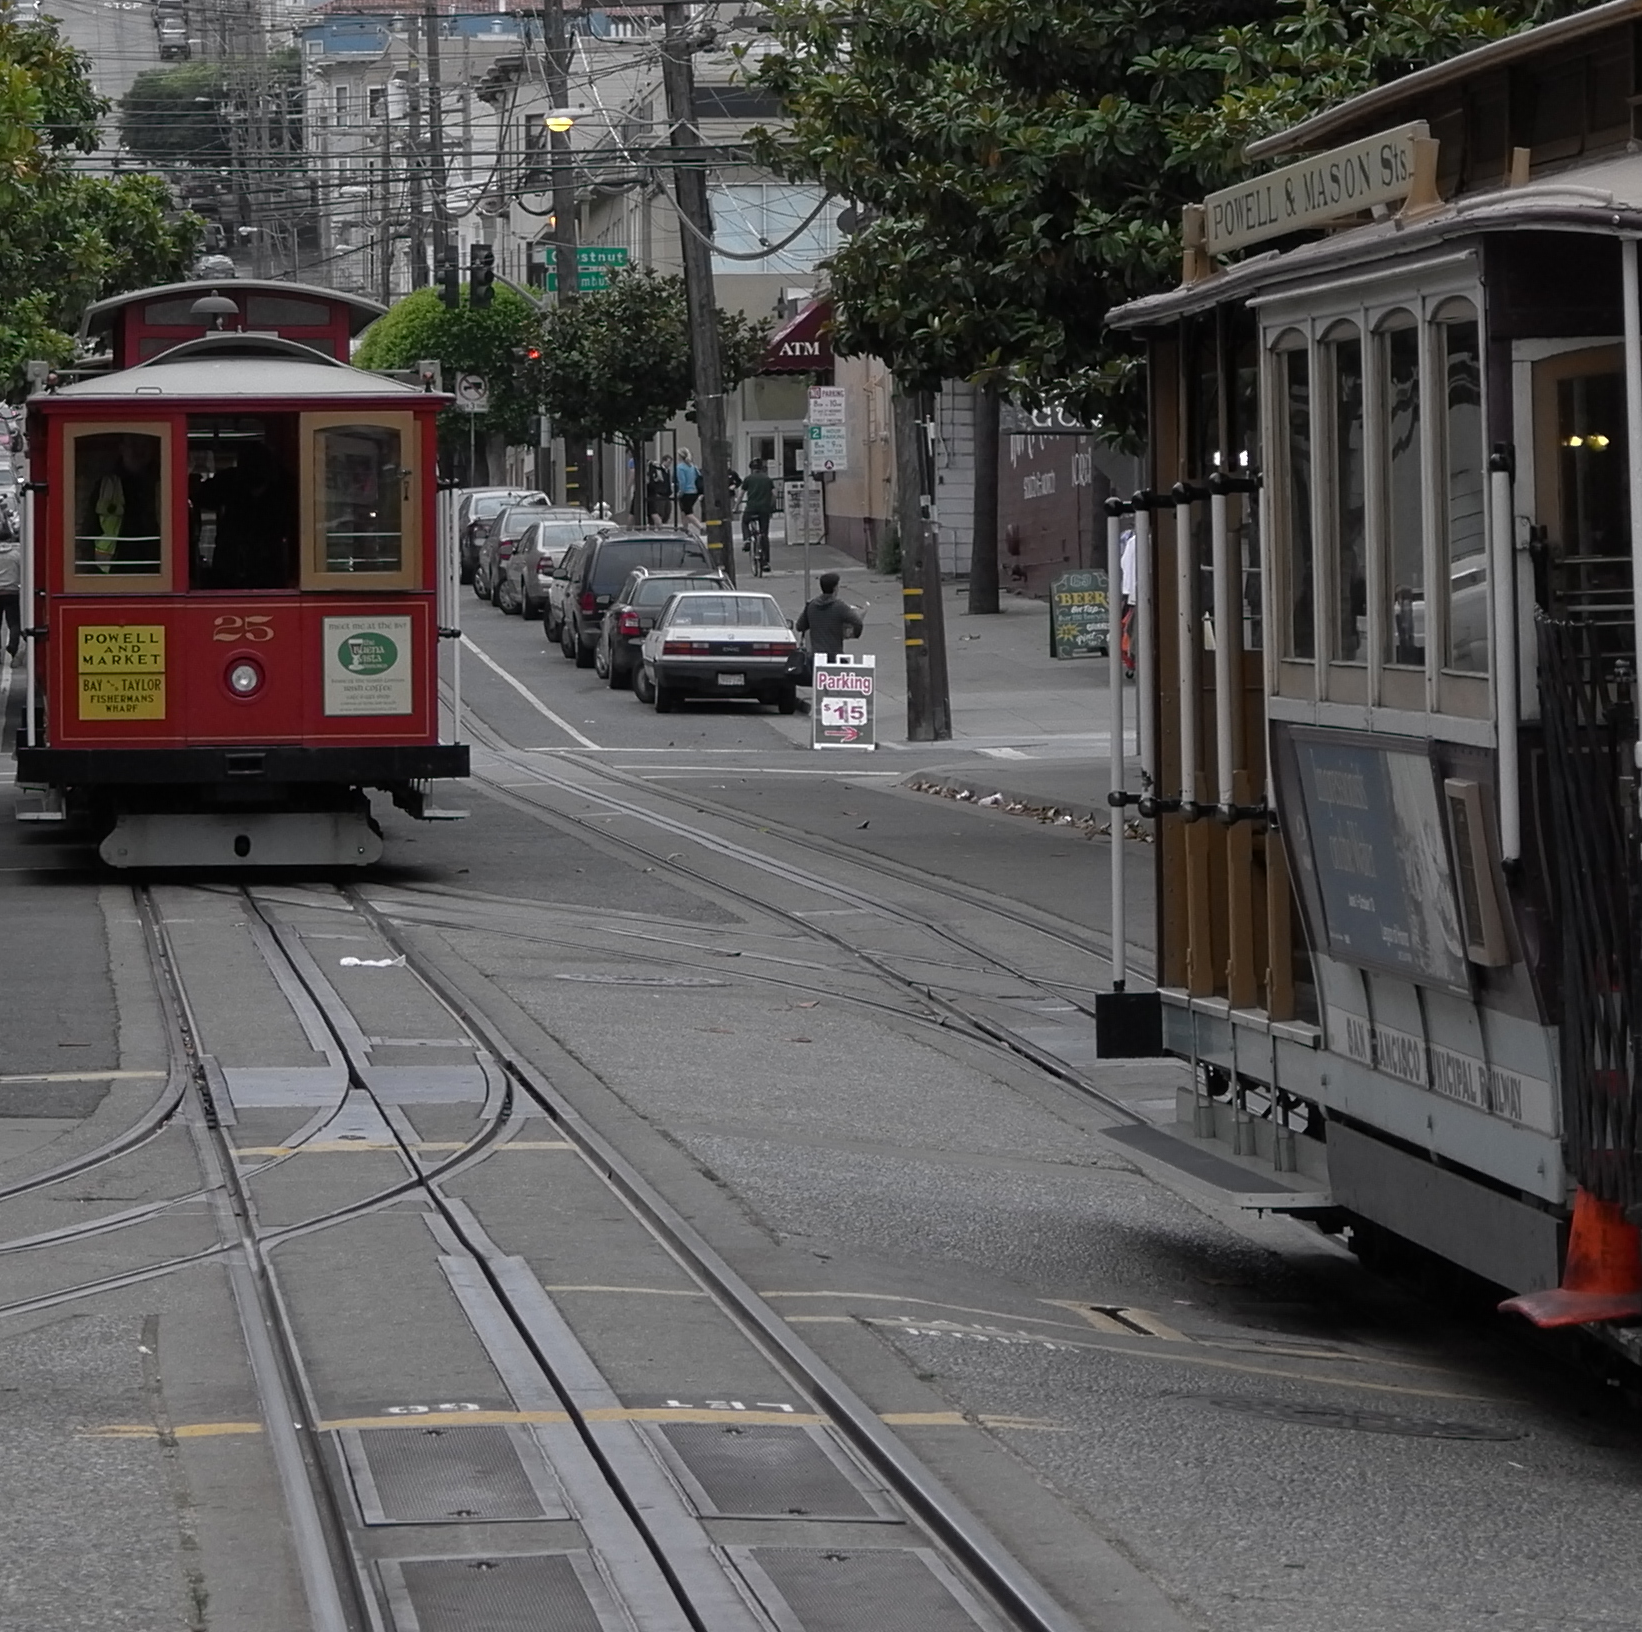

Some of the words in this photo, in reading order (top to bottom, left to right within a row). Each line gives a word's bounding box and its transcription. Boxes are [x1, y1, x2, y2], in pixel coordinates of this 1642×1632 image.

[1213, 186, 1278, 240] POWELL
[1285, 177, 1296, 217] &
[1304, 152, 1371, 212] MASON
[551, 252, 624, 263] Cstnut
[779, 342, 820, 356] ATM
[812, 427, 821, 439] 2
[213, 615, 275, 642] 25
[84, 633, 159, 644] POWELL
[104, 644, 141, 653] AND
[83, 654, 161, 665] MARKET
[83, 679, 102, 692] BAY
[121, 679, 162, 691] TAYLOR
[818, 673, 872, 693] Parking
[90, 694, 154, 704] FISHERMANS
[105, 704, 138, 712] WHARF
[823, 703, 865, 720] $15
[1346, 1016, 1367, 1059] SAN
[1367, 1027, 1421, 1082] ANCISCO
